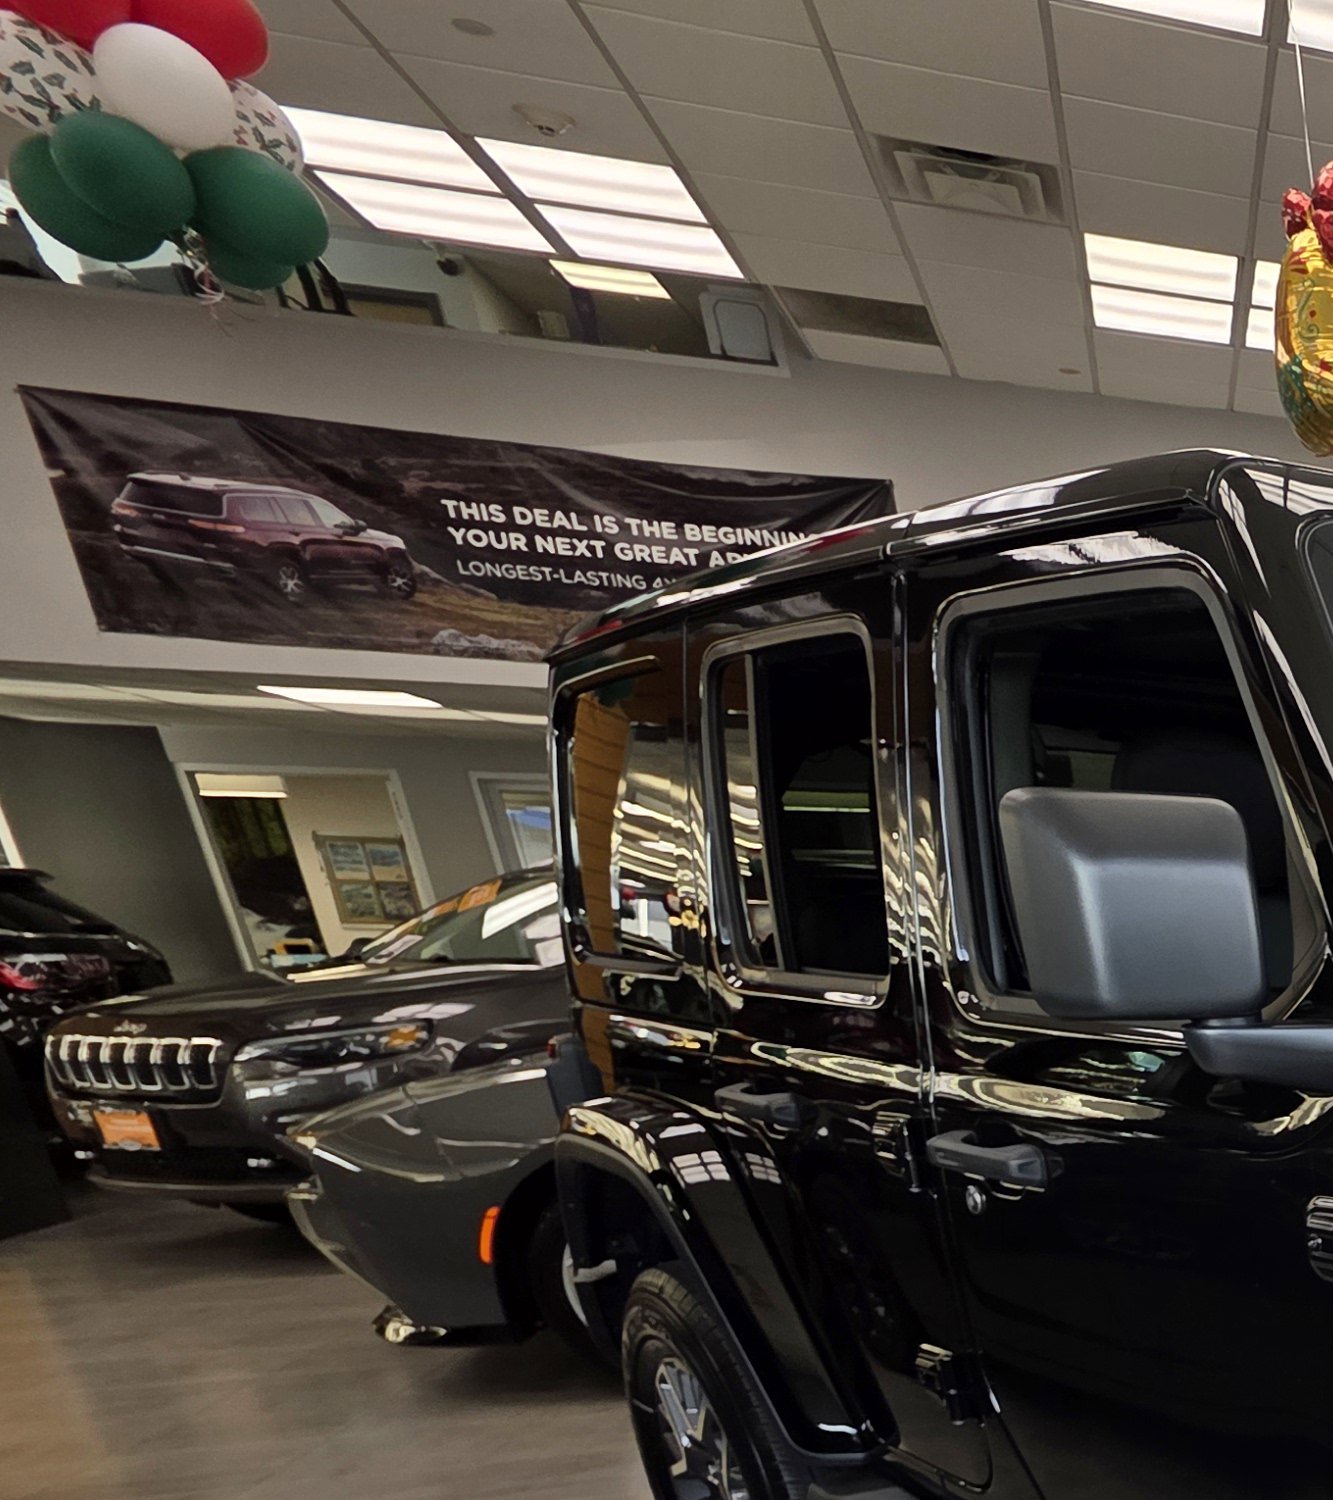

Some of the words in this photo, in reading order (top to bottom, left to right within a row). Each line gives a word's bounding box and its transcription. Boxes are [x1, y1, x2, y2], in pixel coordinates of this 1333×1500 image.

[440, 499, 507, 524] THIS
[512, 506, 588, 532] DEAL
[593, 514, 620, 535] IS
[624, 517, 679, 540] THE
[683, 523, 815, 548] BEGINNIN
[447, 526, 529, 552] YOUR
[534, 534, 606, 559] NEXT
[614, 542, 700, 566] GREAT
[456, 559, 647, 590] LONGEST-LASTING
